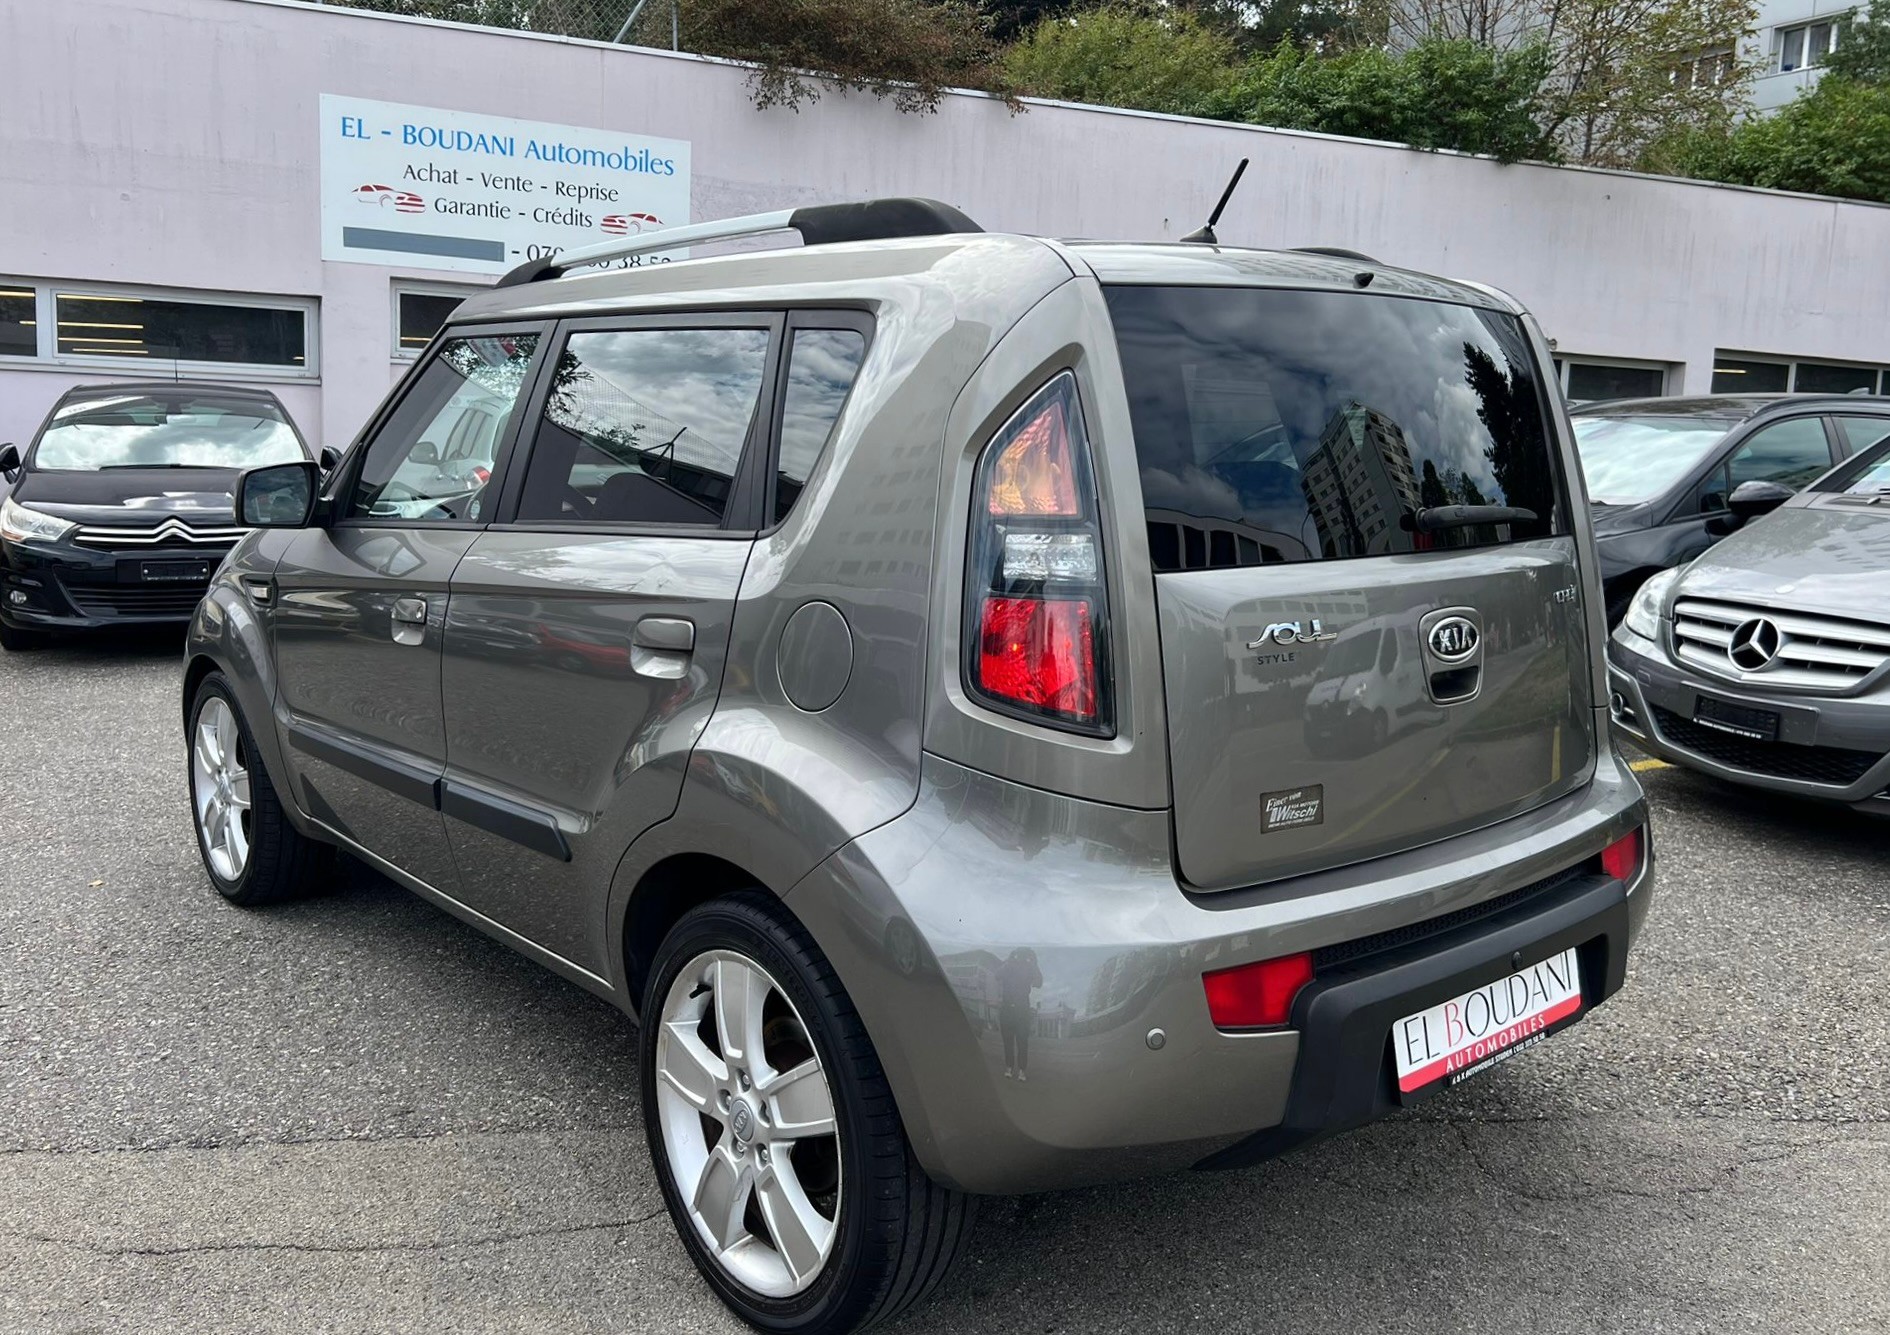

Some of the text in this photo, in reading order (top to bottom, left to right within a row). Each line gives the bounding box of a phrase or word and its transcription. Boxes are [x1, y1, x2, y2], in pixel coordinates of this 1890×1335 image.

[341, 116, 371, 140] EL
[402, 124, 514, 157] BOUDANI
[524, 139, 674, 176] Automobiles
[402, 162, 459, 185] Achat
[480, 172, 533, 193] Vente
[555, 180, 619, 205] Reprise
[434, 197, 511, 220] Garantie
[532, 206, 593, 228] Crédits
[1257, 652, 1295, 665] STYLE
[1438, 623, 1473, 652] KIA
[1403, 951, 1572, 1066] EL BOUDANI
[1445, 1013, 1545, 1074] AUTOMOBILES
